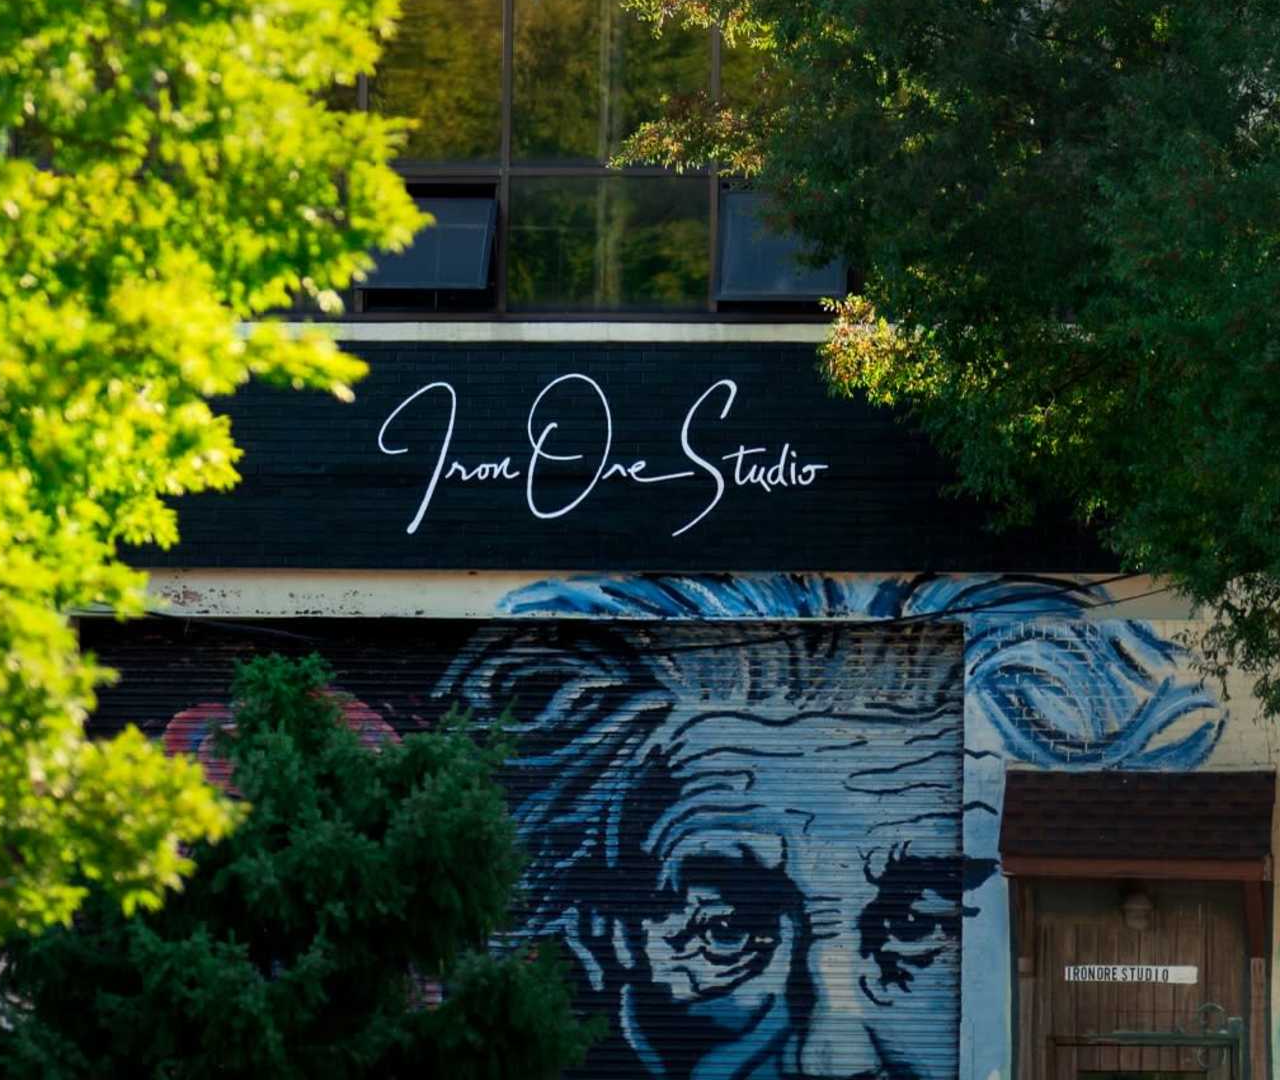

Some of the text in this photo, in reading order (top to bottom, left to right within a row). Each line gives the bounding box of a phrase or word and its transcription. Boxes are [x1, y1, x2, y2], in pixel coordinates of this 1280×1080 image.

[378, 373, 828, 537] Iron Ore Studio
[1121, 968, 1169, 982] STUDIO
